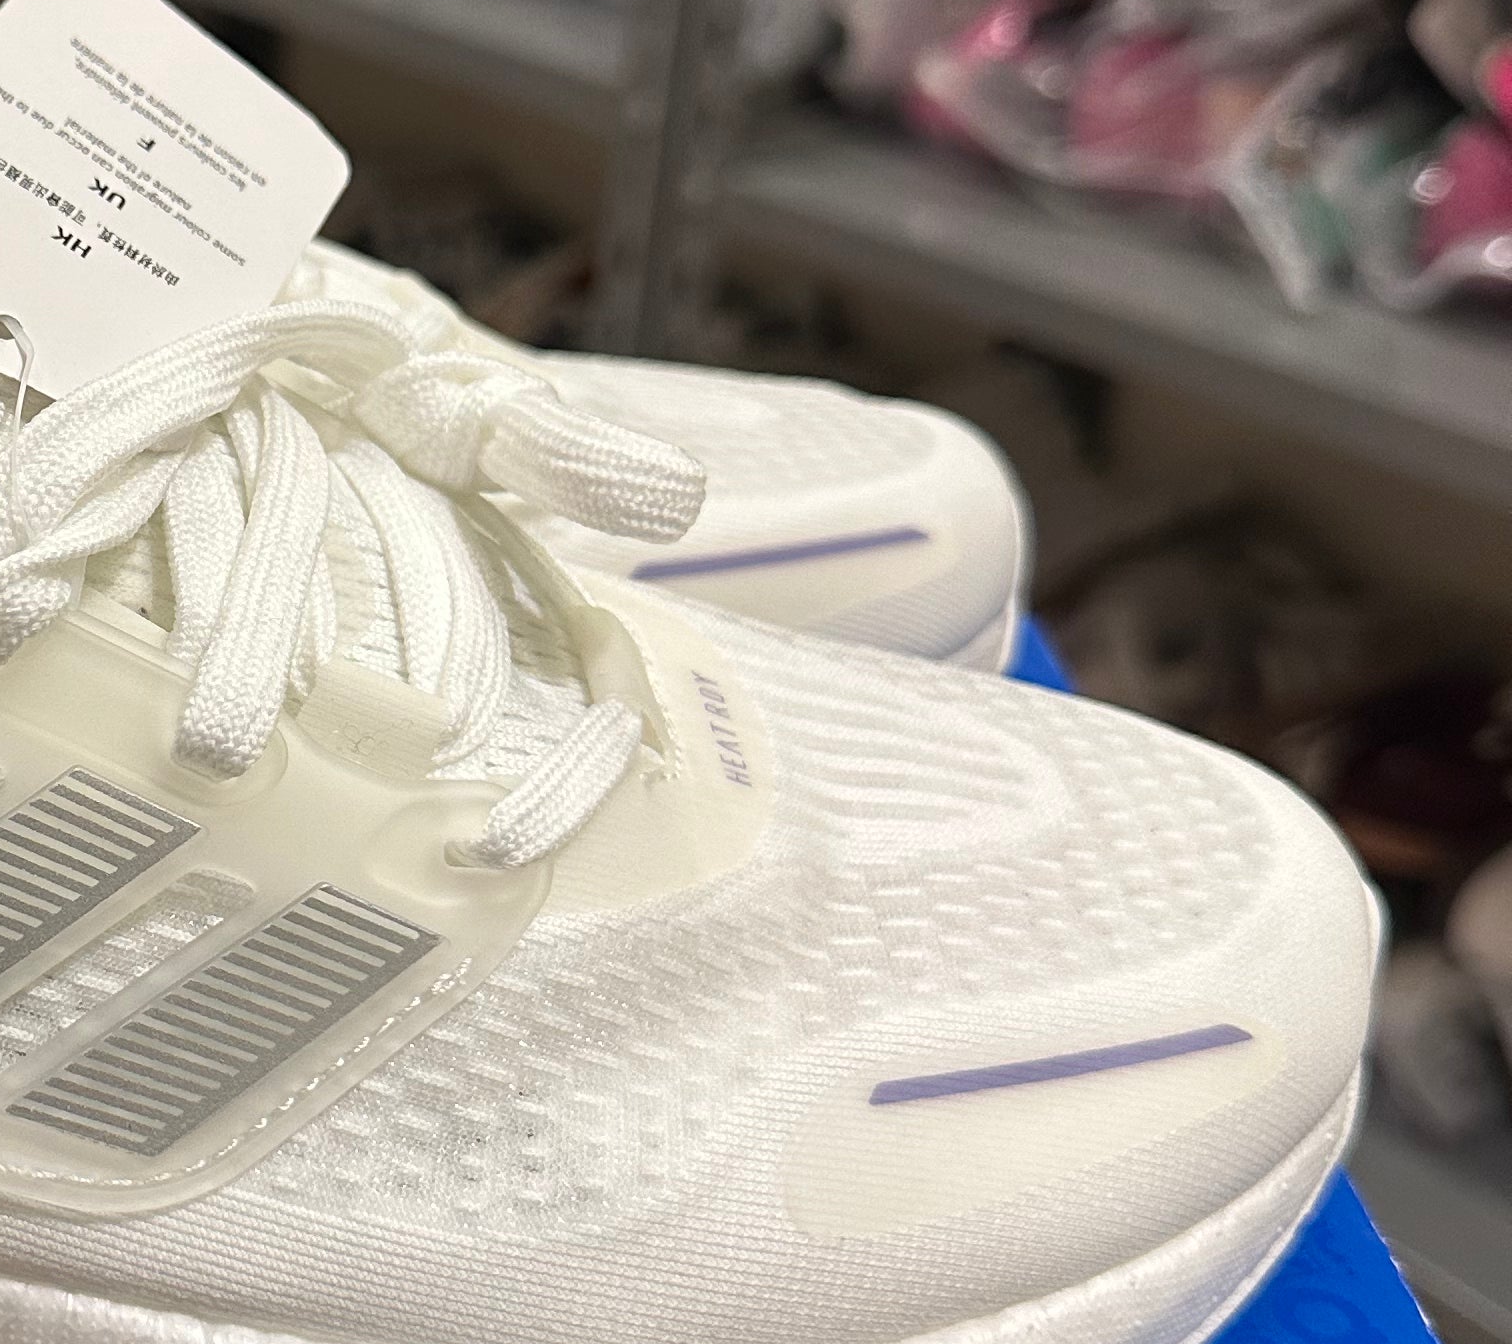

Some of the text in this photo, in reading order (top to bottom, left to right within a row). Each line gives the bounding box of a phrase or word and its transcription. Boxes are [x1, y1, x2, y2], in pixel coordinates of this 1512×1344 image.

[116, 71, 130, 87] la
[128, 81, 146, 97] de
[14, 100, 31, 115] to
[29, 109, 55, 131] due
[183, 122, 198, 138] la
[53, 128, 91, 156] occur
[136, 137, 157, 153] F
[197, 132, 214, 148] de
[90, 152, 115, 173] can
[116, 154, 139, 175] the
[136, 169, 153, 183] of
[227, 172, 247, 193] les
[88, 177, 127, 211] UK
[113, 168, 174, 215] migration
[151, 179, 193, 212] nature
[171, 211, 212, 242] colour
[50, 224, 93, 259] HK
[211, 238, 247, 268] some
[710, 721, 753, 788] HEAT
